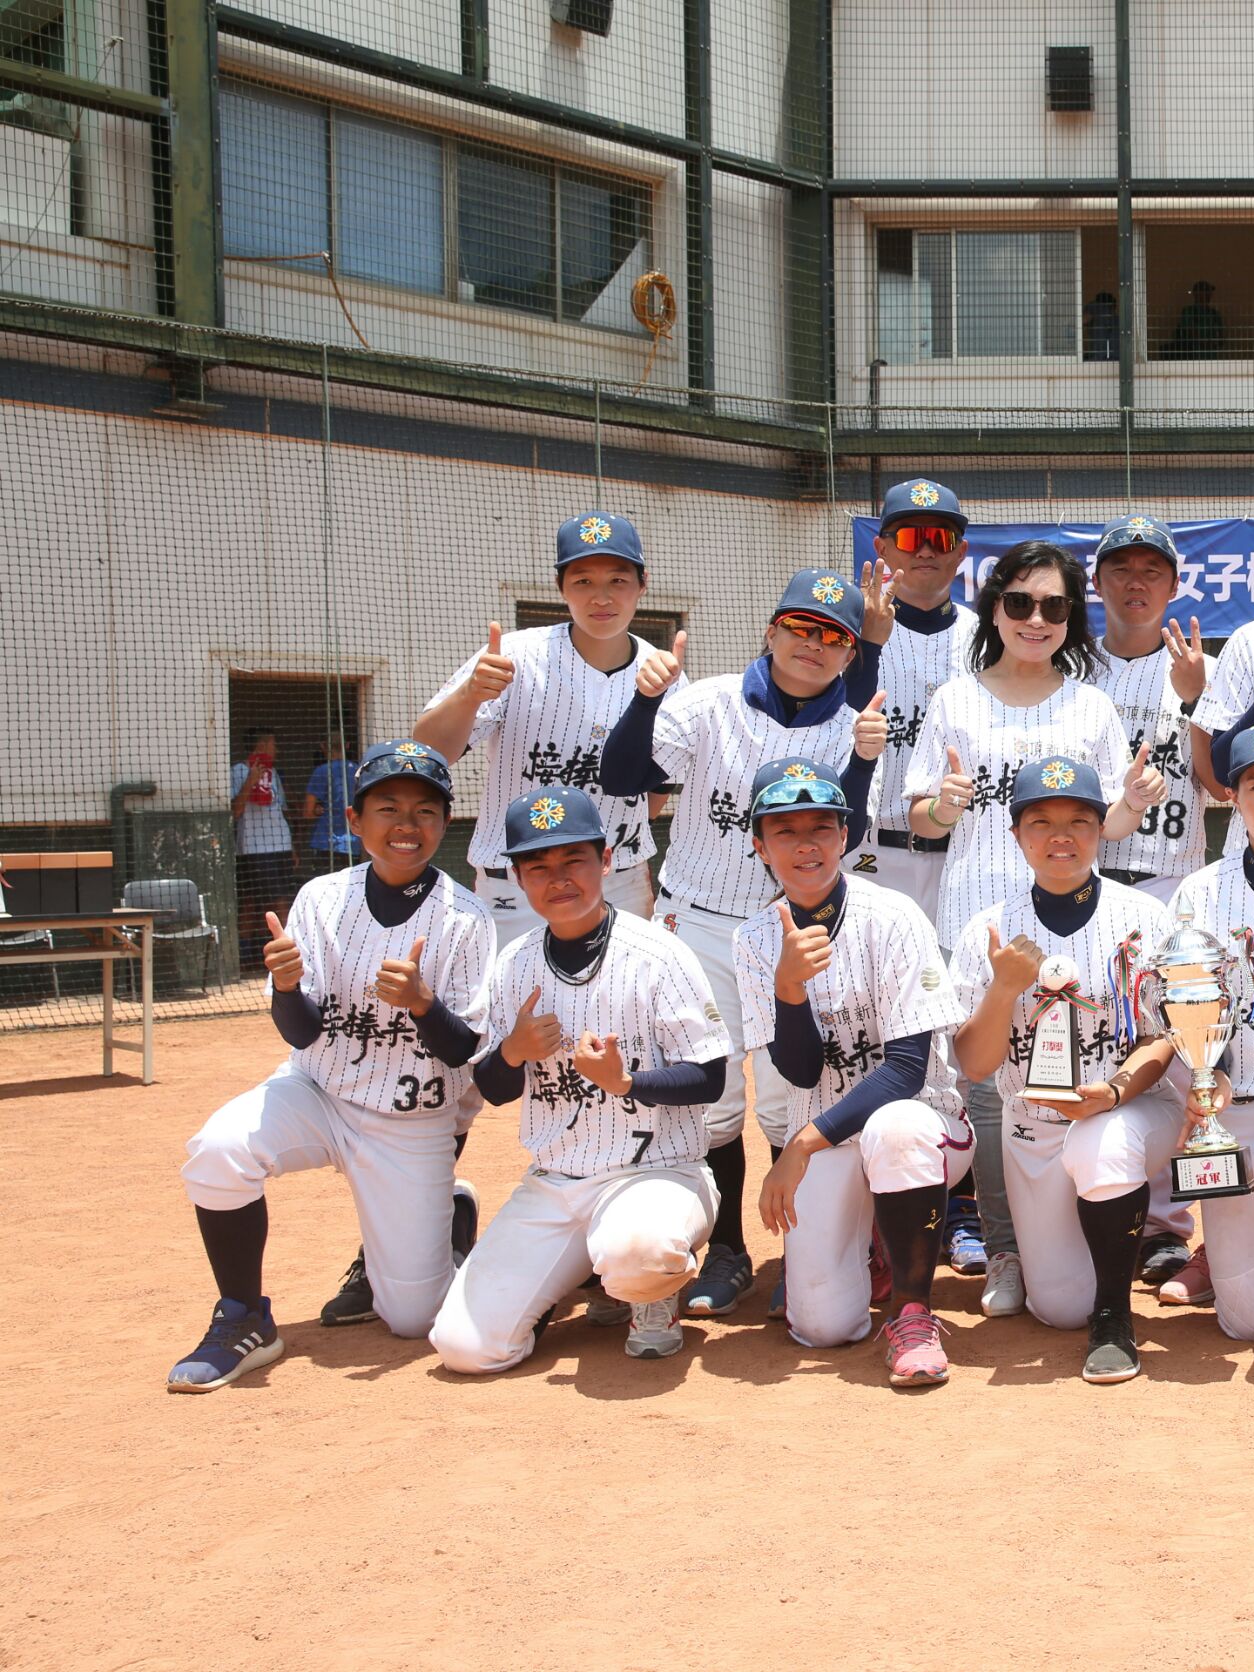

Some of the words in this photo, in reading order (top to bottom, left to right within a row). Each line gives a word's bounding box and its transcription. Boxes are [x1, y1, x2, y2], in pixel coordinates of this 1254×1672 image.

[612, 822, 641, 855] 14
[394, 1074, 445, 1112] 33
[631, 1130, 654, 1164] 7
